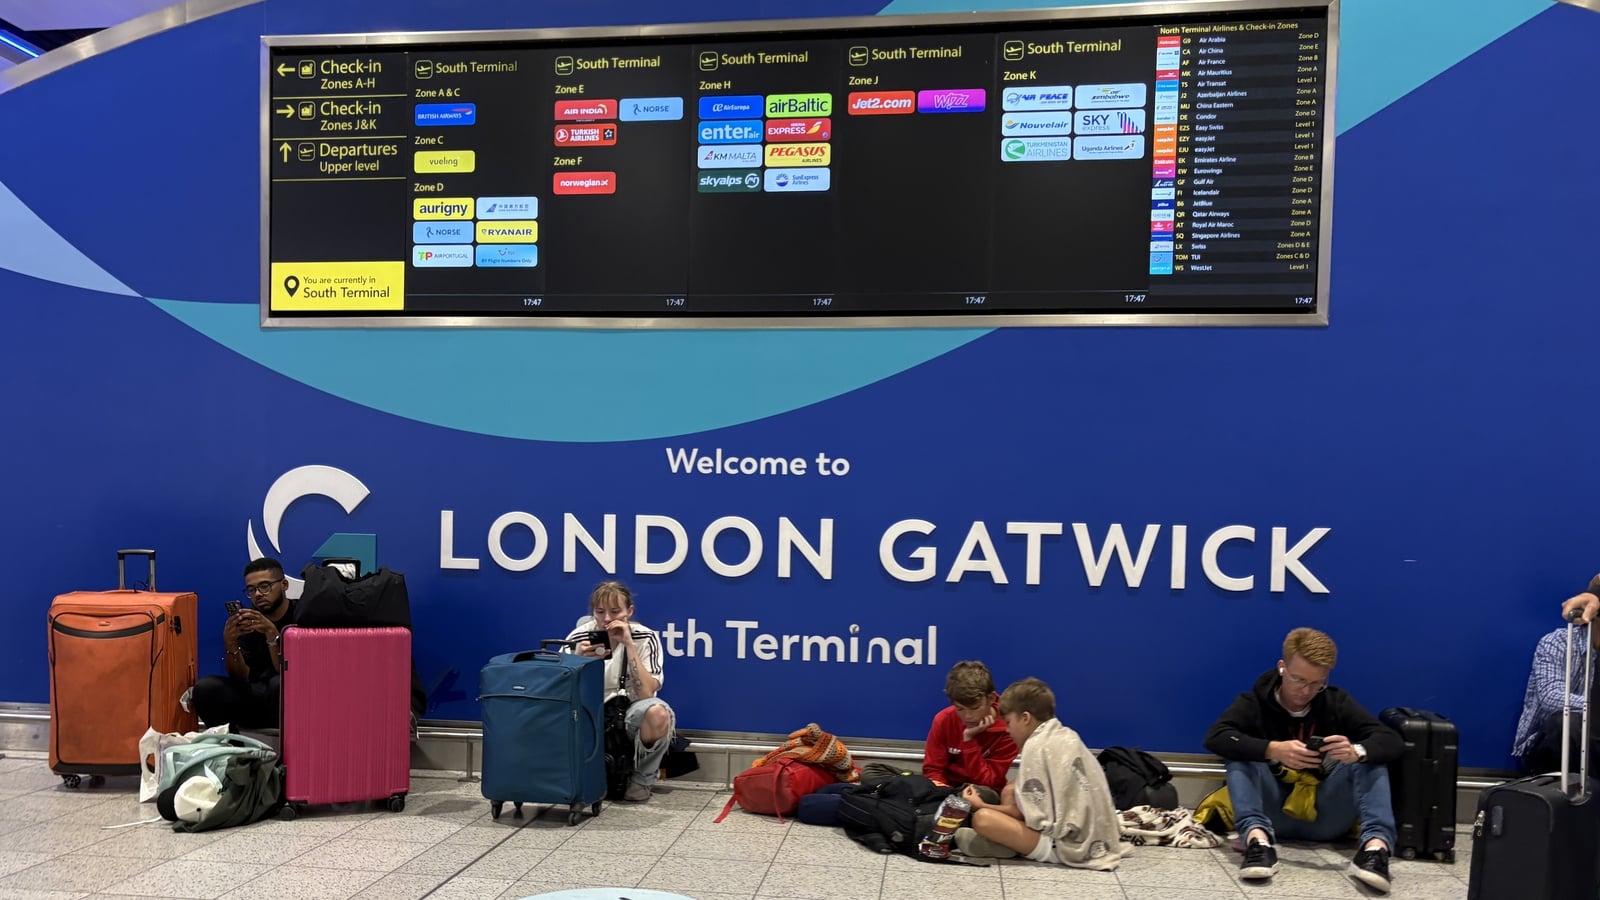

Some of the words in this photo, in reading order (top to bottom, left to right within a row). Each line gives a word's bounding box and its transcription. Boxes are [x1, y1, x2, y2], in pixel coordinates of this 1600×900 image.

[1160, 26, 1180, 35] North
[1181, 26, 1211, 34] Terminal
[1028, 41, 1064, 54] South
[1066, 39, 1121, 53] Terminal
[721, 53, 755, 65] South
[757, 51, 808, 64] Terminal
[872, 48, 906, 60] South
[909, 46, 962, 58] Terminal
[321, 59, 381, 74] Check-in
[436, 62, 468, 73] South
[470, 61, 517, 72] Terminal
[576, 57, 609, 70] South
[611, 56, 660, 68] Terminal
[849, 76, 872, 85] Zone
[1003, 71, 1028, 80] Zone
[1030, 70, 1036, 79] K
[321, 78, 353, 89] Zones
[355, 77, 375, 88] A-H
[699, 81, 722, 90] Zone
[724, 80, 731, 89] H
[415, 89, 437, 98] Zone
[446, 88, 453, 97] &
[555, 85, 577, 94] Zone
[320, 100, 381, 115] Check-in
[769, 98, 828, 113] airBaltic
[852, 98, 912, 109] Jet2.com
[320, 120, 353, 131] Zones
[355, 119, 376, 130] J&K
[1083, 114, 1110, 126] SKY
[701, 124, 750, 140] enter
[768, 126, 806, 135] EXPRESS
[414, 136, 436, 145] Zone
[320, 143, 397, 160] Departures
[769, 146, 826, 157] PEGASUS
[1026, 148, 1068, 157] AIRLINES
[320, 161, 353, 174] Upper
[355, 160, 379, 171] level
[429, 156, 458, 168] vueling
[554, 157, 576, 166] Zone
[560, 179, 601, 188] norwegian
[699, 175, 742, 187] skyalps
[414, 183, 435, 192] Zone
[437, 183, 444, 191] D
[419, 201, 468, 217] aurigny
[303, 276, 318, 284] You
[333, 275, 367, 286] currently
[303, 286, 337, 298] South
[340, 286, 390, 298] Terminal
[666, 448, 807, 475] Welcome
[815, 452, 850, 476] to
[440, 510, 834, 581] LONDON
[879, 518, 1331, 594] GATWICK
[726, 620, 937, 665] Terminal
